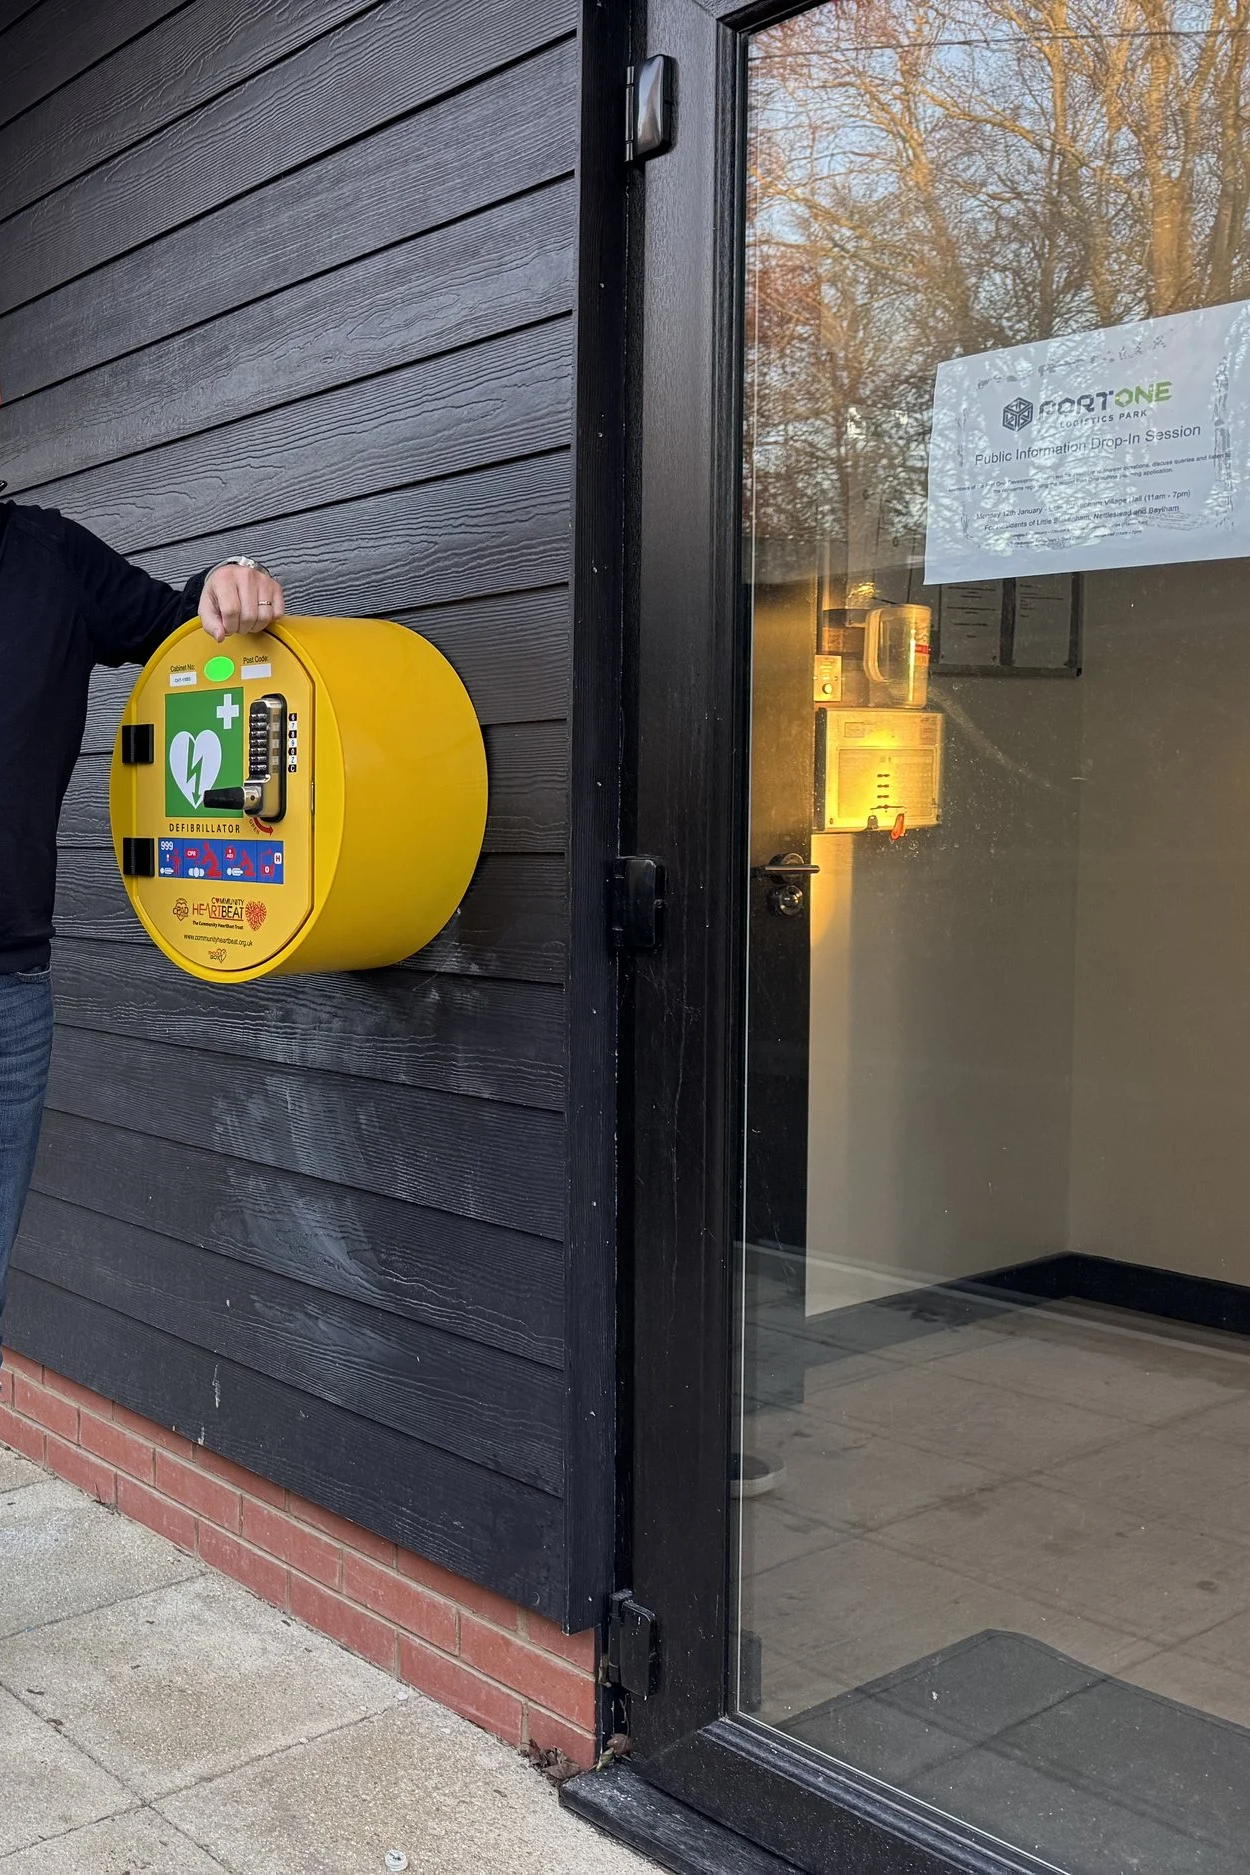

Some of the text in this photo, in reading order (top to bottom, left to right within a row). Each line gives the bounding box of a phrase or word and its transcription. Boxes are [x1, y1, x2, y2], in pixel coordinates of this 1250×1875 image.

[1060, 409, 1148, 429] LOGISTICS PARK
[975, 424, 1201, 466] Public Information Drop-In Session
[1017, 506, 1043, 516] January
[1104, 496, 1127, 506] Village
[1172, 489, 1191, 500] 7pm)
[1132, 507, 1146, 515] and
[243, 656, 254, 664] Post
[170, 664, 187, 672] Cabinet
[169, 822, 241, 833] DEFIBRILLATOR
[160, 841, 174, 851] 999
[192, 902, 244, 920] HEARTBEAT
[199, 921, 218, 929] Community
[184, 934, 253, 948] www.communityheartbeat.org.uk
